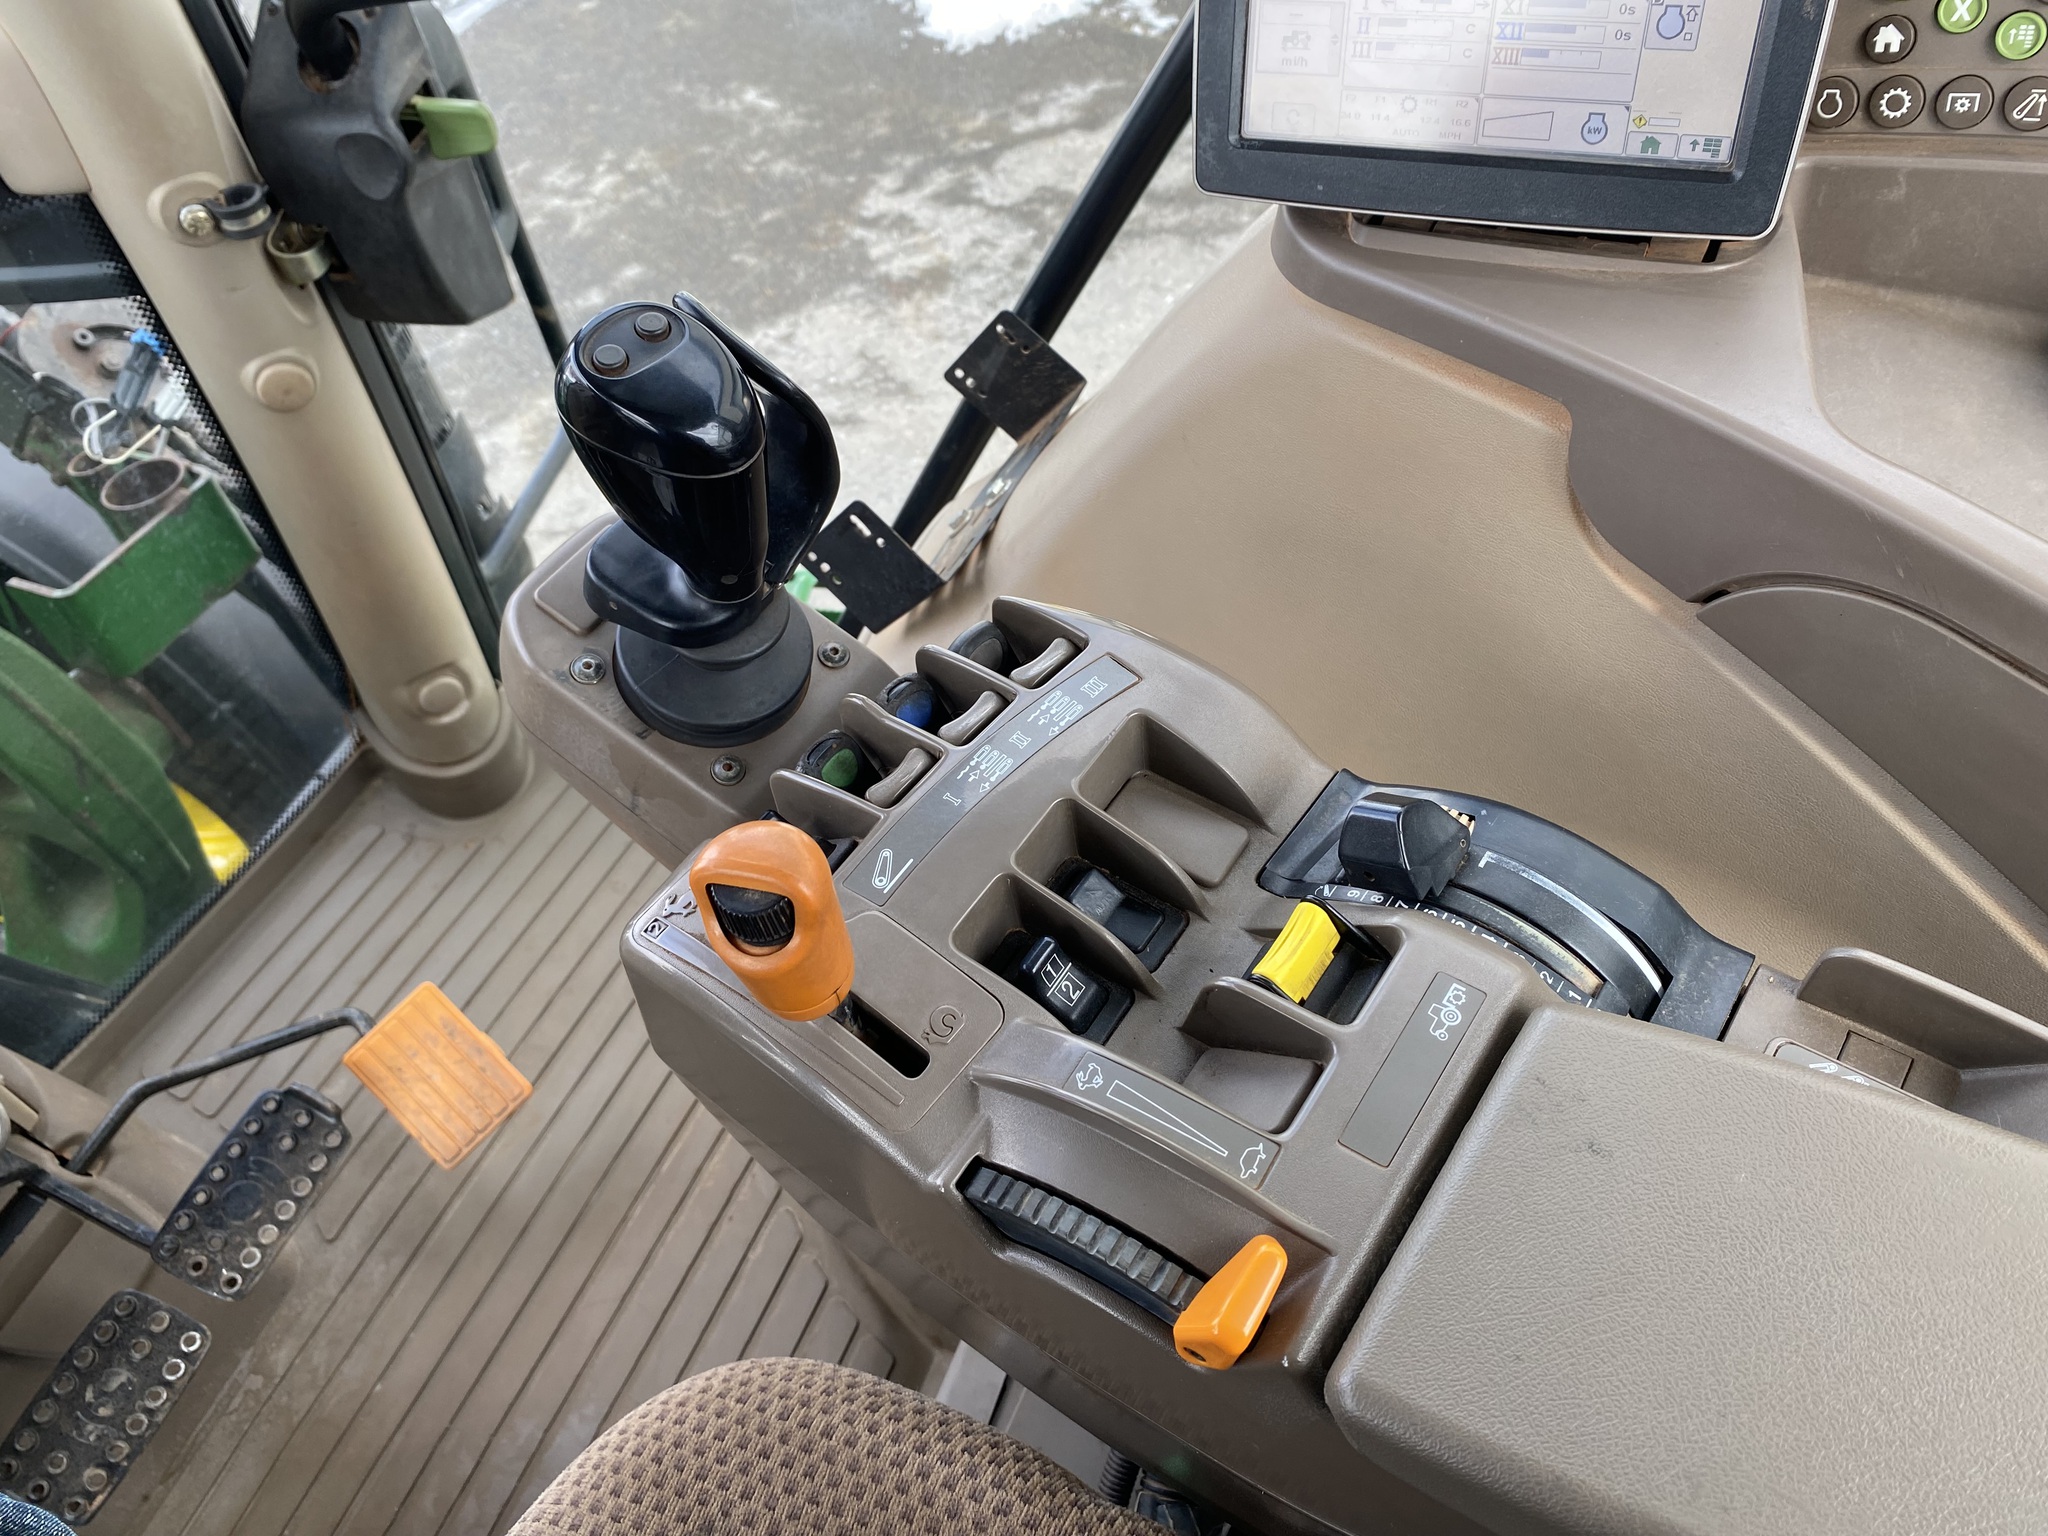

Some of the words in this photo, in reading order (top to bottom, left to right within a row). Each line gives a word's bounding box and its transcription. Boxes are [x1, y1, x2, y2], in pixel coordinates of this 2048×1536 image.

[1618, 3, 1636, 16] 0s
[1357, 17, 1371, 35] II
[1465, 23, 1476, 34] C
[1494, 21, 1524, 41] XII
[1614, 29, 1632, 41] 0s
[1351, 40, 1372, 59] III
[1462, 48, 1473, 59] C
[1491, 46, 1521, 66] XIII
[1281, 56, 1308, 67] mi/h
[1456, 100, 1469, 109] R2
[1438, 131, 1462, 141] MPH
[1587, 126, 1603, 136] kW
[645, 920, 665, 938] 2
[1046, 962, 1057, 978] 1
[1061, 980, 1081, 1000] 2
